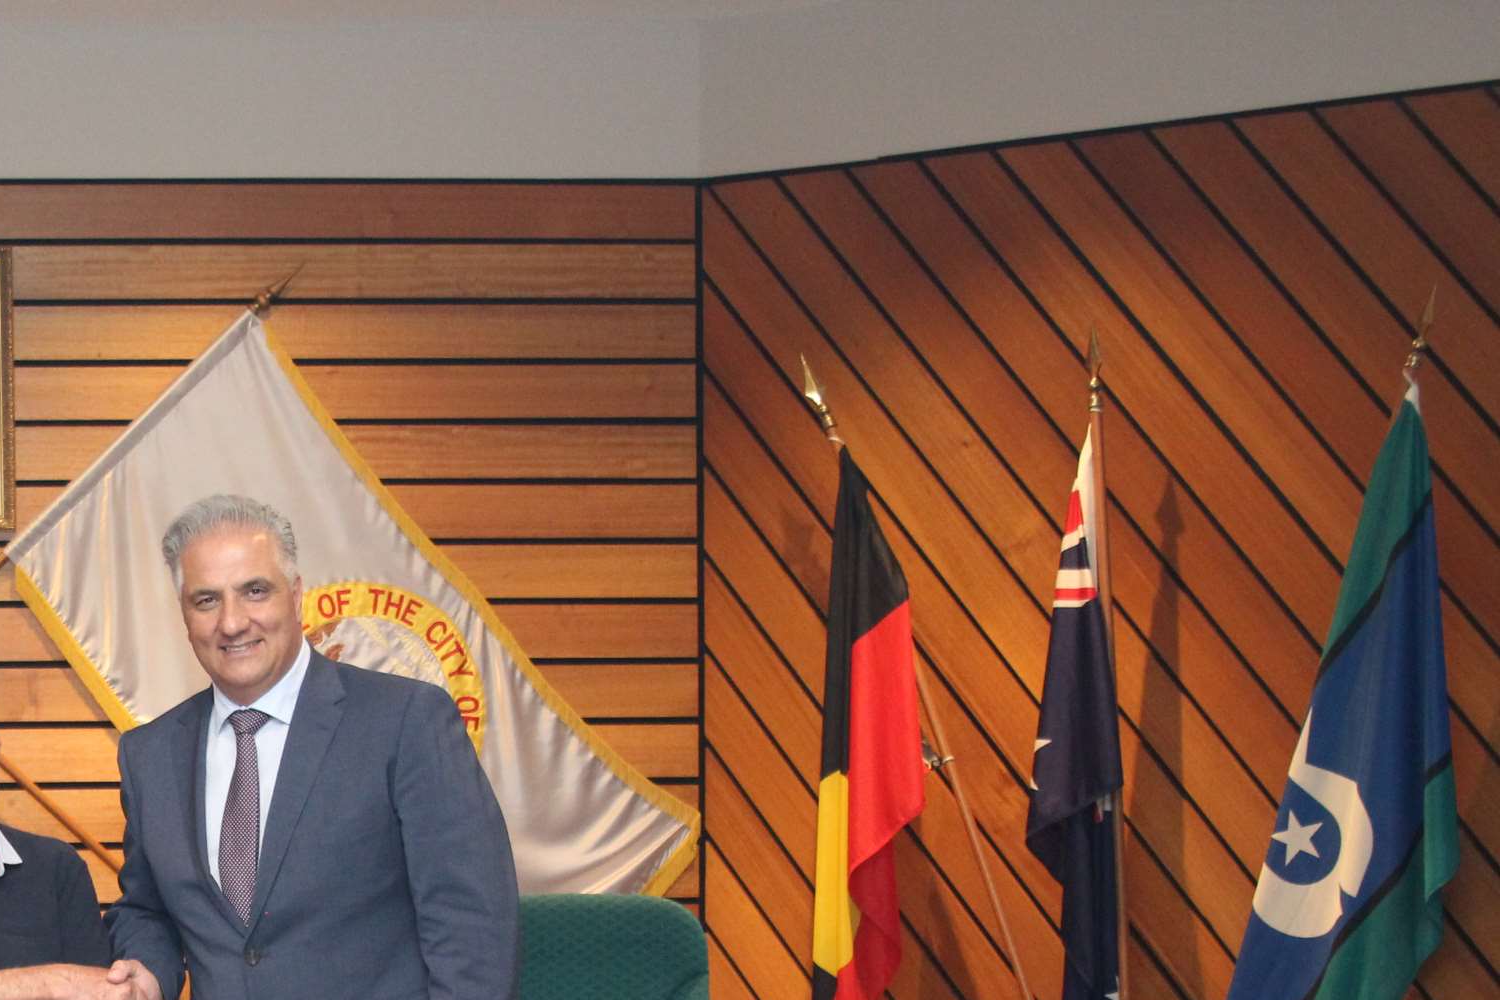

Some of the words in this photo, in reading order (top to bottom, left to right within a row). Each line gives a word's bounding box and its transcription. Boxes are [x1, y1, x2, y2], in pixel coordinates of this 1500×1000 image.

[317, 589, 352, 619] OF
[368, 588, 424, 627] THE
[425, 621, 474, 677] CITY
